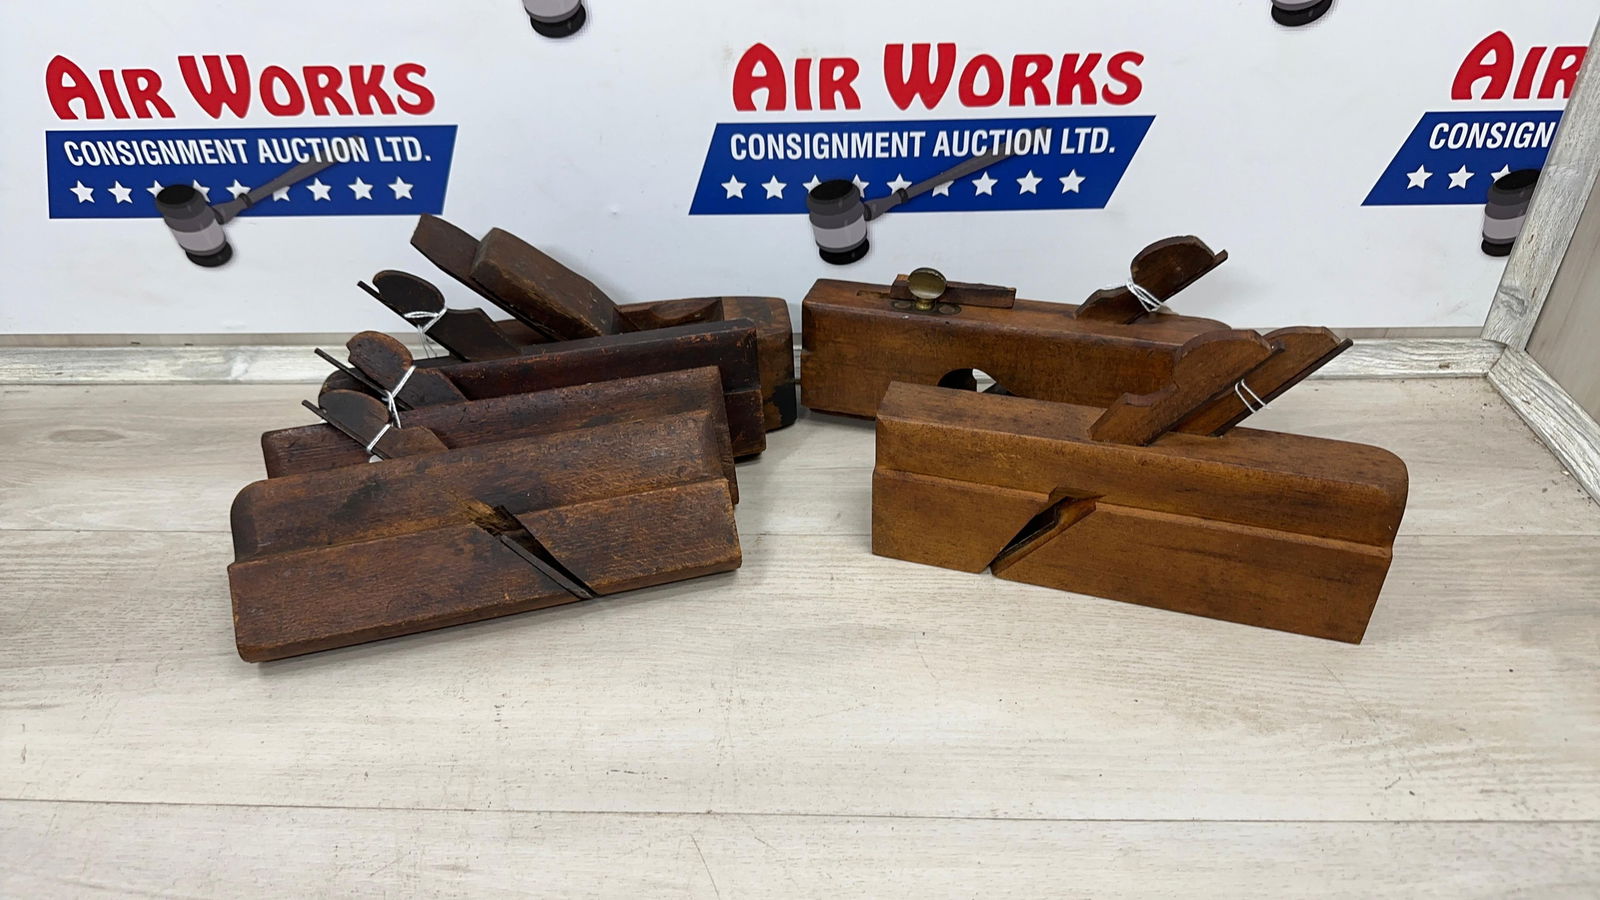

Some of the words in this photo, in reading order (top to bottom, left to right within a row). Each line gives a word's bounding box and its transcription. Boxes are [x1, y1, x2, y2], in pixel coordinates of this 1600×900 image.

[46, 55, 176, 120] AIR
[178, 54, 436, 119] WORKS
[732, 42, 861, 111] AIR
[884, 42, 1145, 110] WORKS
[63, 138, 247, 167] CONSIGNMENT
[258, 136, 370, 164] AUCTION
[375, 136, 431, 162] LTD.
[730, 131, 926, 161] CONSIGNMENT
[932, 128, 1052, 157] AUCTION
[1060, 127, 1115, 154] LTD.
[1429, 121, 1556, 149] CONSIGN
